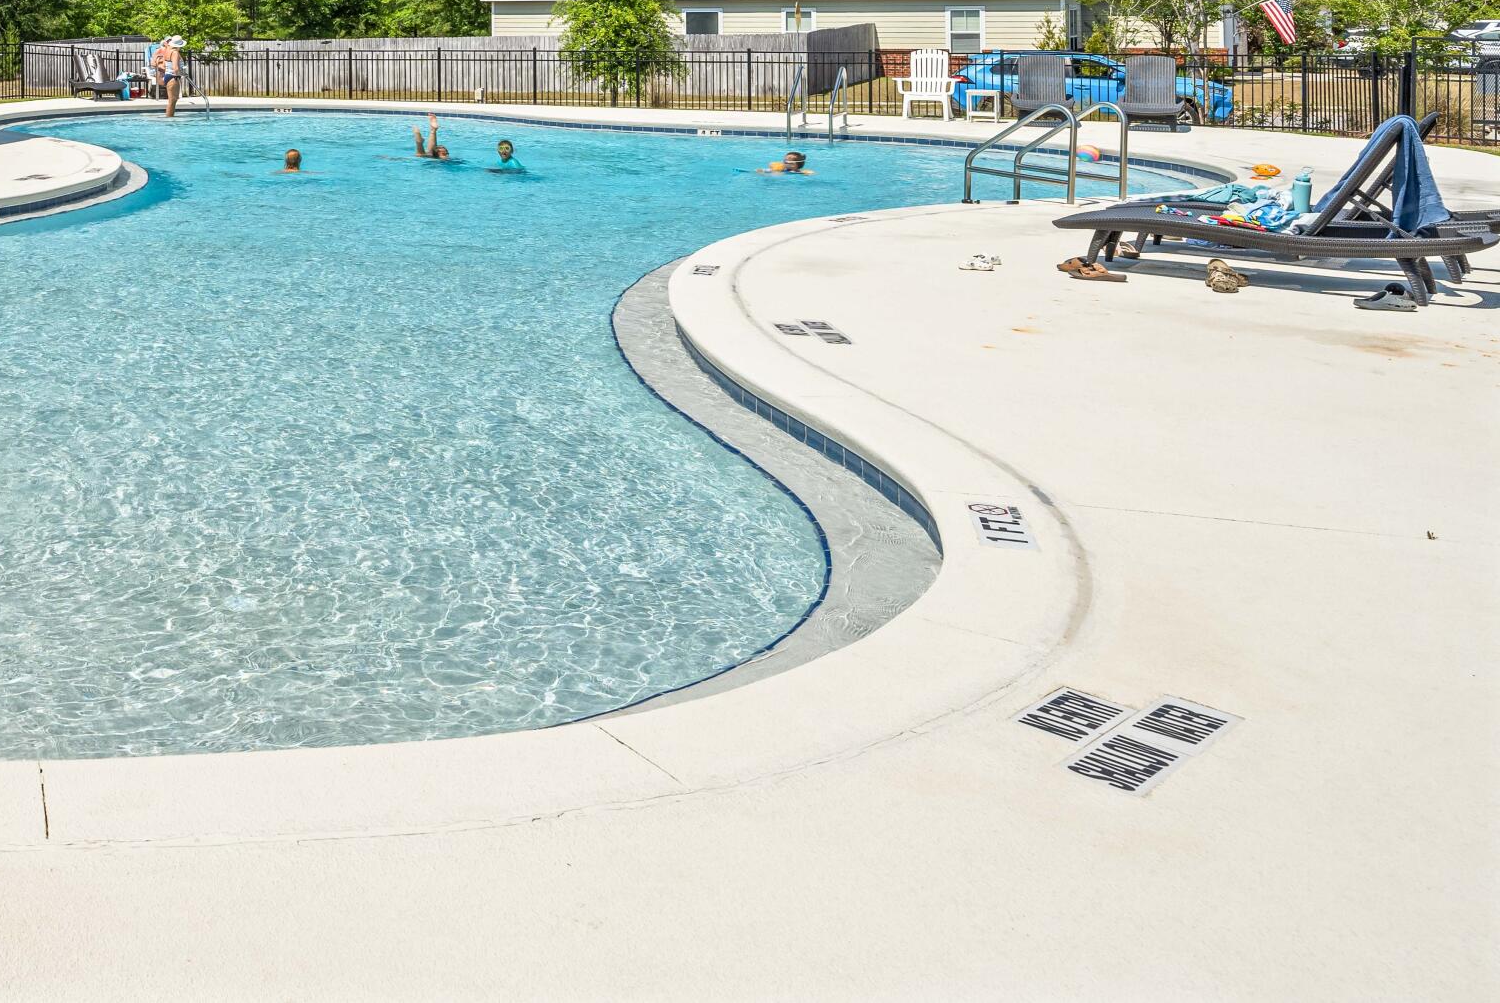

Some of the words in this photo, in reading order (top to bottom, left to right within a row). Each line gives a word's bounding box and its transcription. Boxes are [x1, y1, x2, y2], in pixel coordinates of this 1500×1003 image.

[1018, 713, 1089, 741] NO
[1036, 691, 1124, 730] ENTRY
[1067, 735, 1179, 791] SHALLOW
[1132, 704, 1229, 744] WATER
